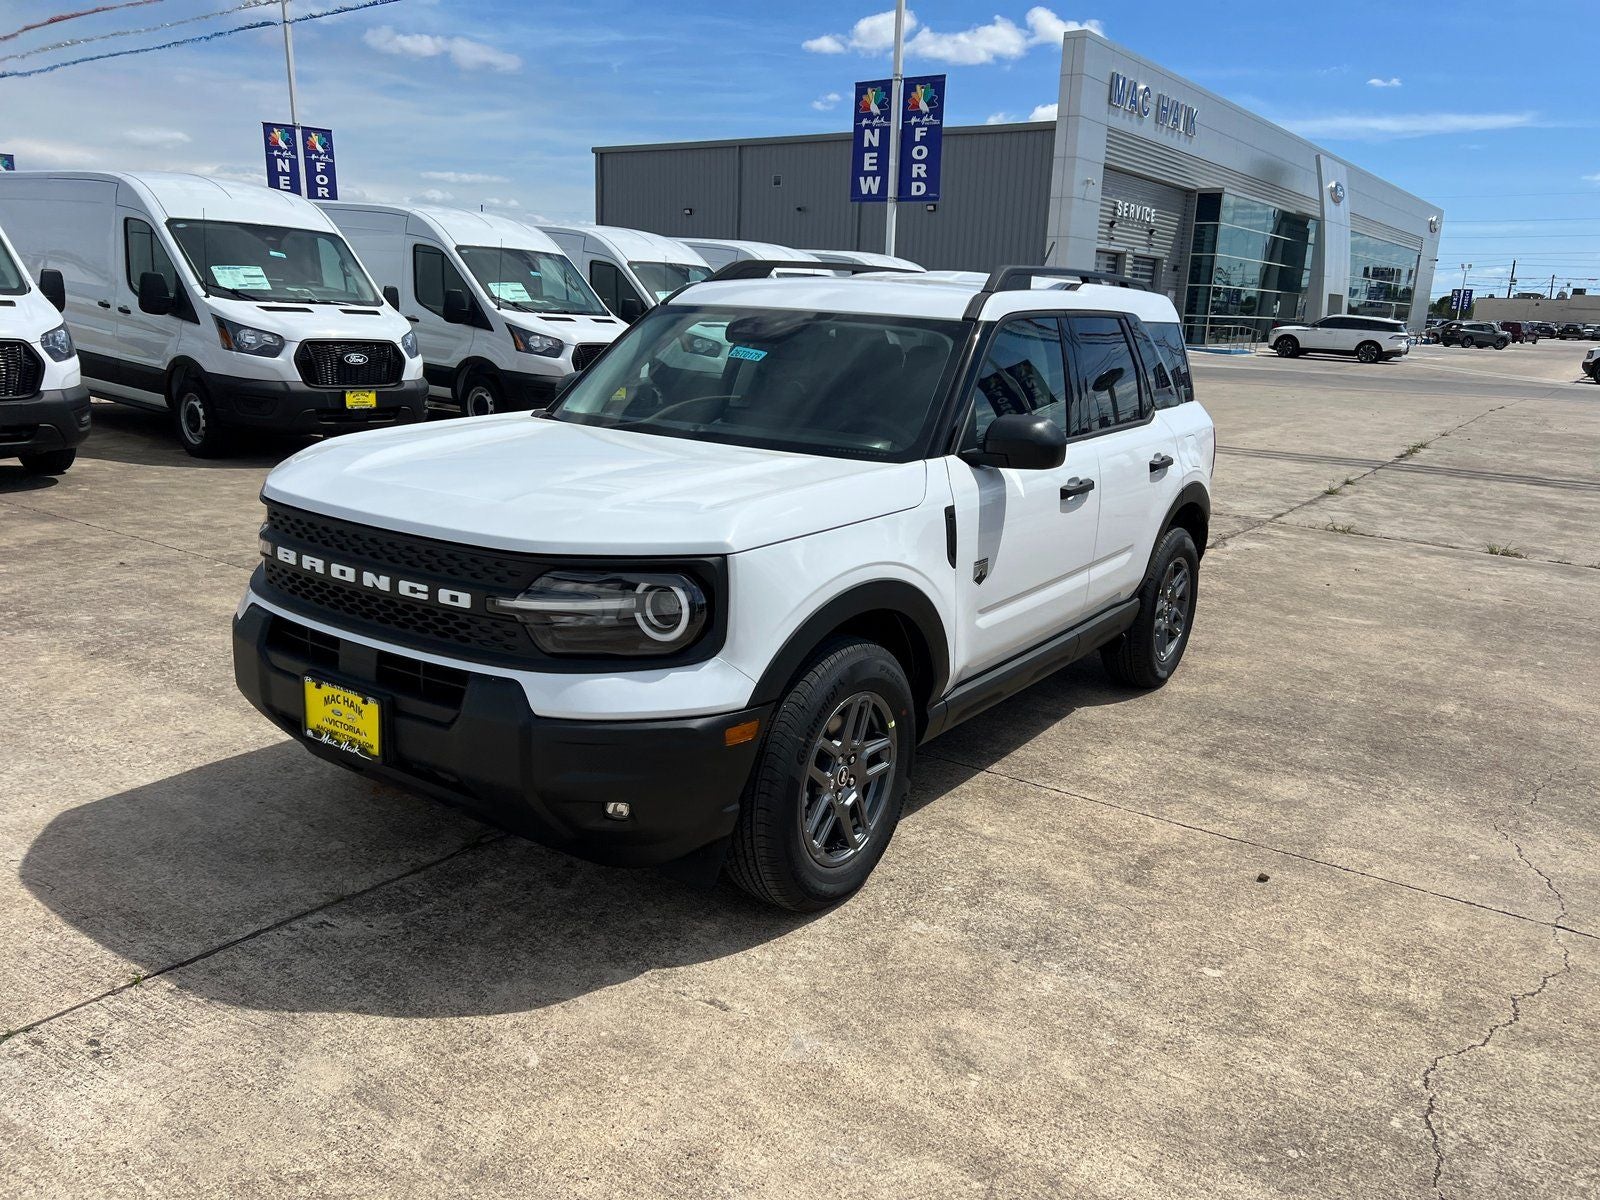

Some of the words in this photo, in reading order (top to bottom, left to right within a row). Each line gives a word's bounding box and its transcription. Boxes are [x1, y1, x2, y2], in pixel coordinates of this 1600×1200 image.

[1110, 72, 1152, 118] MAC
[1156, 94, 1198, 138] HAIK
[276, 158, 291, 190] NE
[859, 128, 881, 195] NEW
[911, 127, 929, 196] FORD
[315, 161, 330, 198] FOR
[1117, 200, 1156, 222] SERVICE
[347, 354, 366, 364] Ford
[277, 546, 472, 609] BRONCO
[323, 694, 341, 707] MAC
[343, 695, 364, 719] HAIK
[328, 717, 360, 736] VICTORIA
